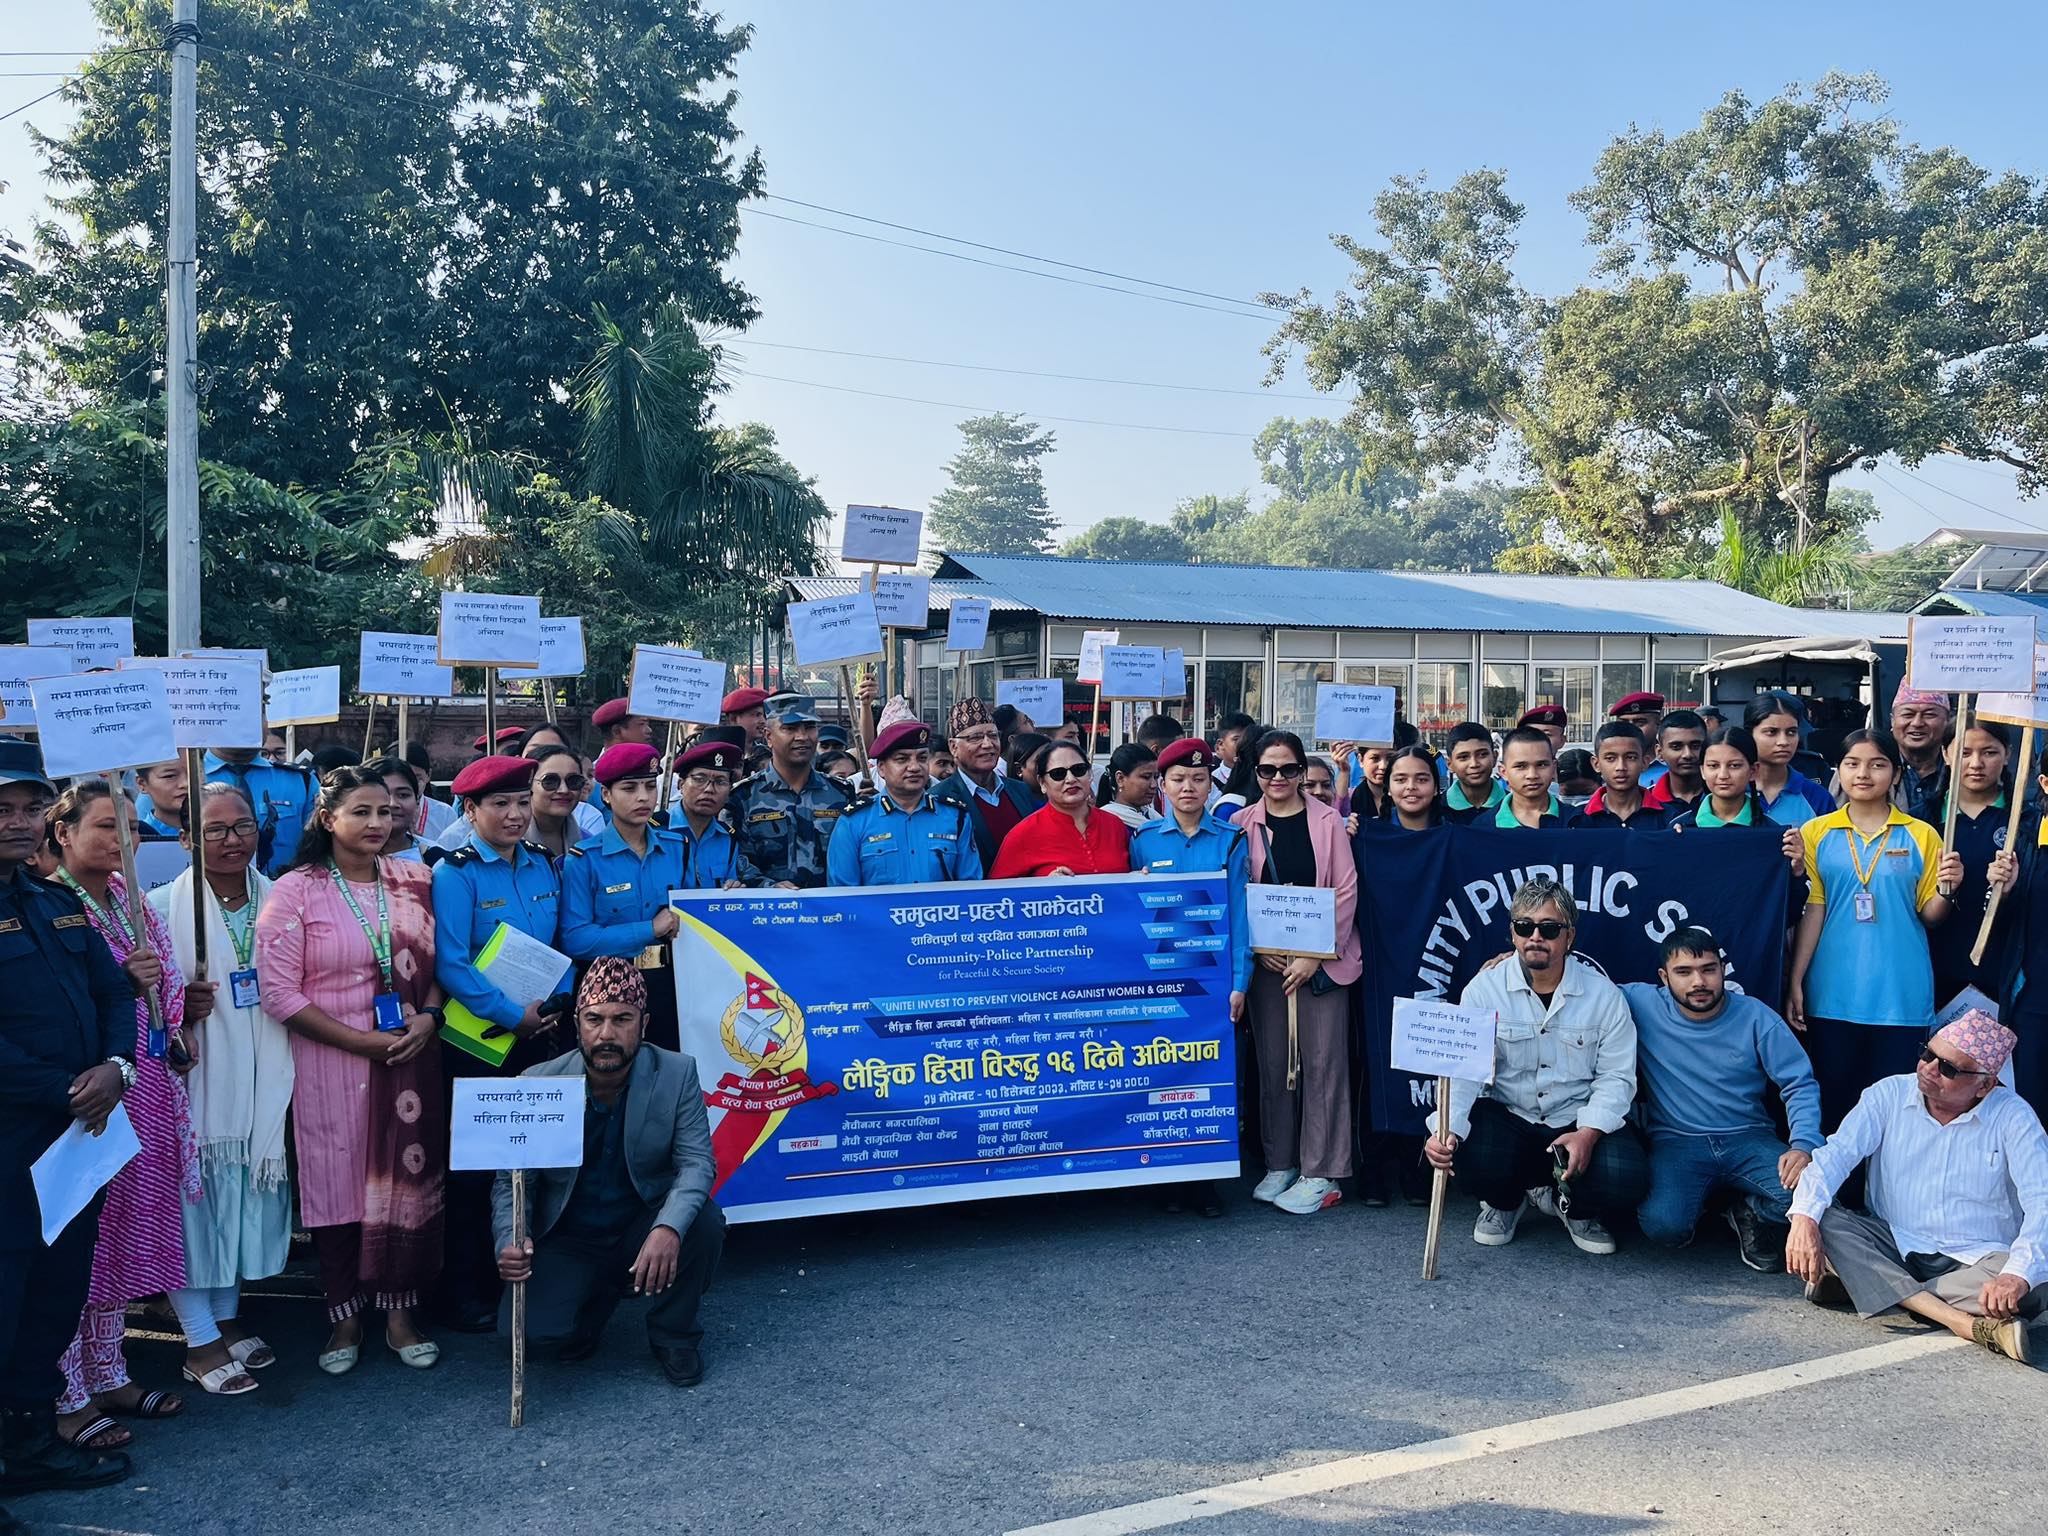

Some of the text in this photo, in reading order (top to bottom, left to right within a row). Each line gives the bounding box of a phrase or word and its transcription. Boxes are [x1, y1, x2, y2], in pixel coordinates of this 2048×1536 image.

[889, 893, 1104, 928] समुदाय-प्रहरी साझेदारी
[906, 944, 1094, 966] Community-Police Partnership
[1414, 898, 1471, 1003] MITY
[938, 964, 1066, 980] for Peaceful & Secure Society
[881, 983, 1185, 1013] "UNITE! INVEST TO PREVENT VIOLENCE AGAINIST WOMEN & GIRLS"
[923, 1053, 975, 1085] हिंसा
[1047, 1050, 1076, 1074] १६
[1083, 1040, 1125, 1071] दिने
[1131, 1036, 1221, 1067] अभियान
[477, 1088, 523, 1102] घरघरबाटै
[526, 1092, 544, 1106] शुरु
[473, 1111, 565, 1125] महिला हिंसा अन्त्य
[842, 1116, 940, 1131] मेचीनगर नगरपालिका
[842, 1129, 958, 1147] मेची सामुदायिक सेवा केन्द्र
[842, 1149, 898, 1163] माइती नेपाल
